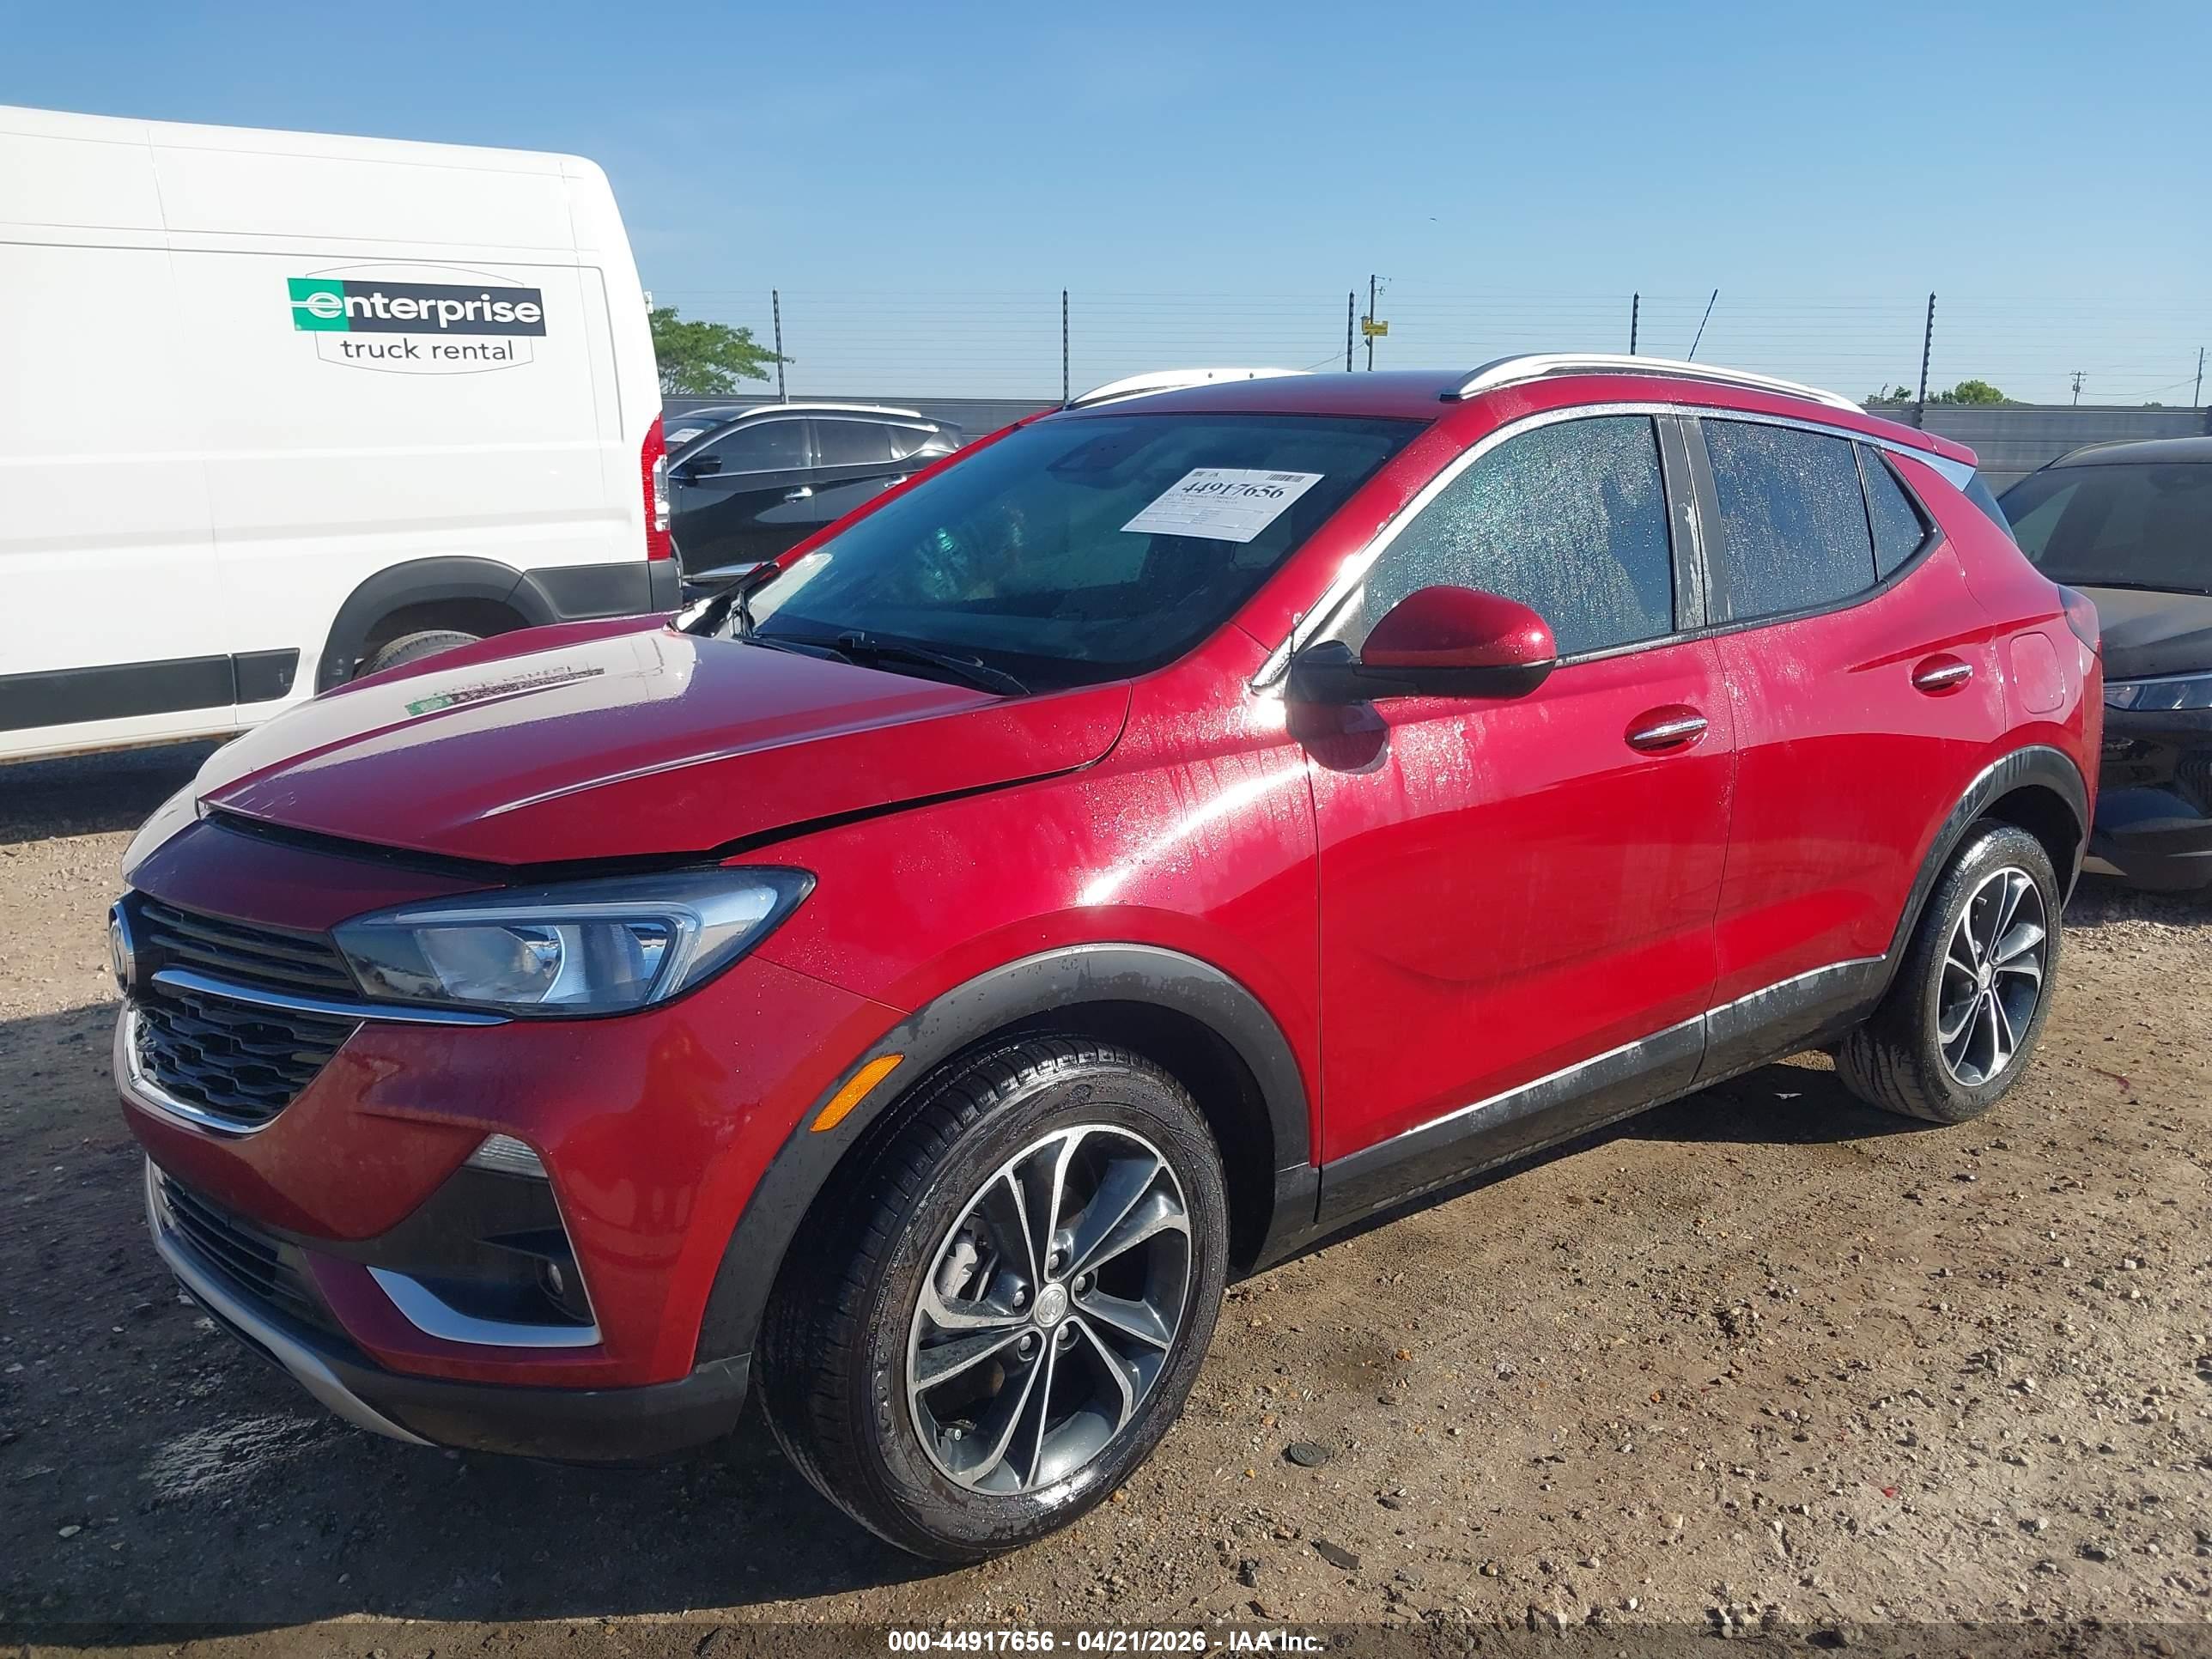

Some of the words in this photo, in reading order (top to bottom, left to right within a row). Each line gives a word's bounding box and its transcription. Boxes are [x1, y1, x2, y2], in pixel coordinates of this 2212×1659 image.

[290, 291, 542, 328] enterprise
[340, 337, 421, 359] truck
[432, 340, 514, 361] rental
[1182, 481, 1290, 499] 44917656
